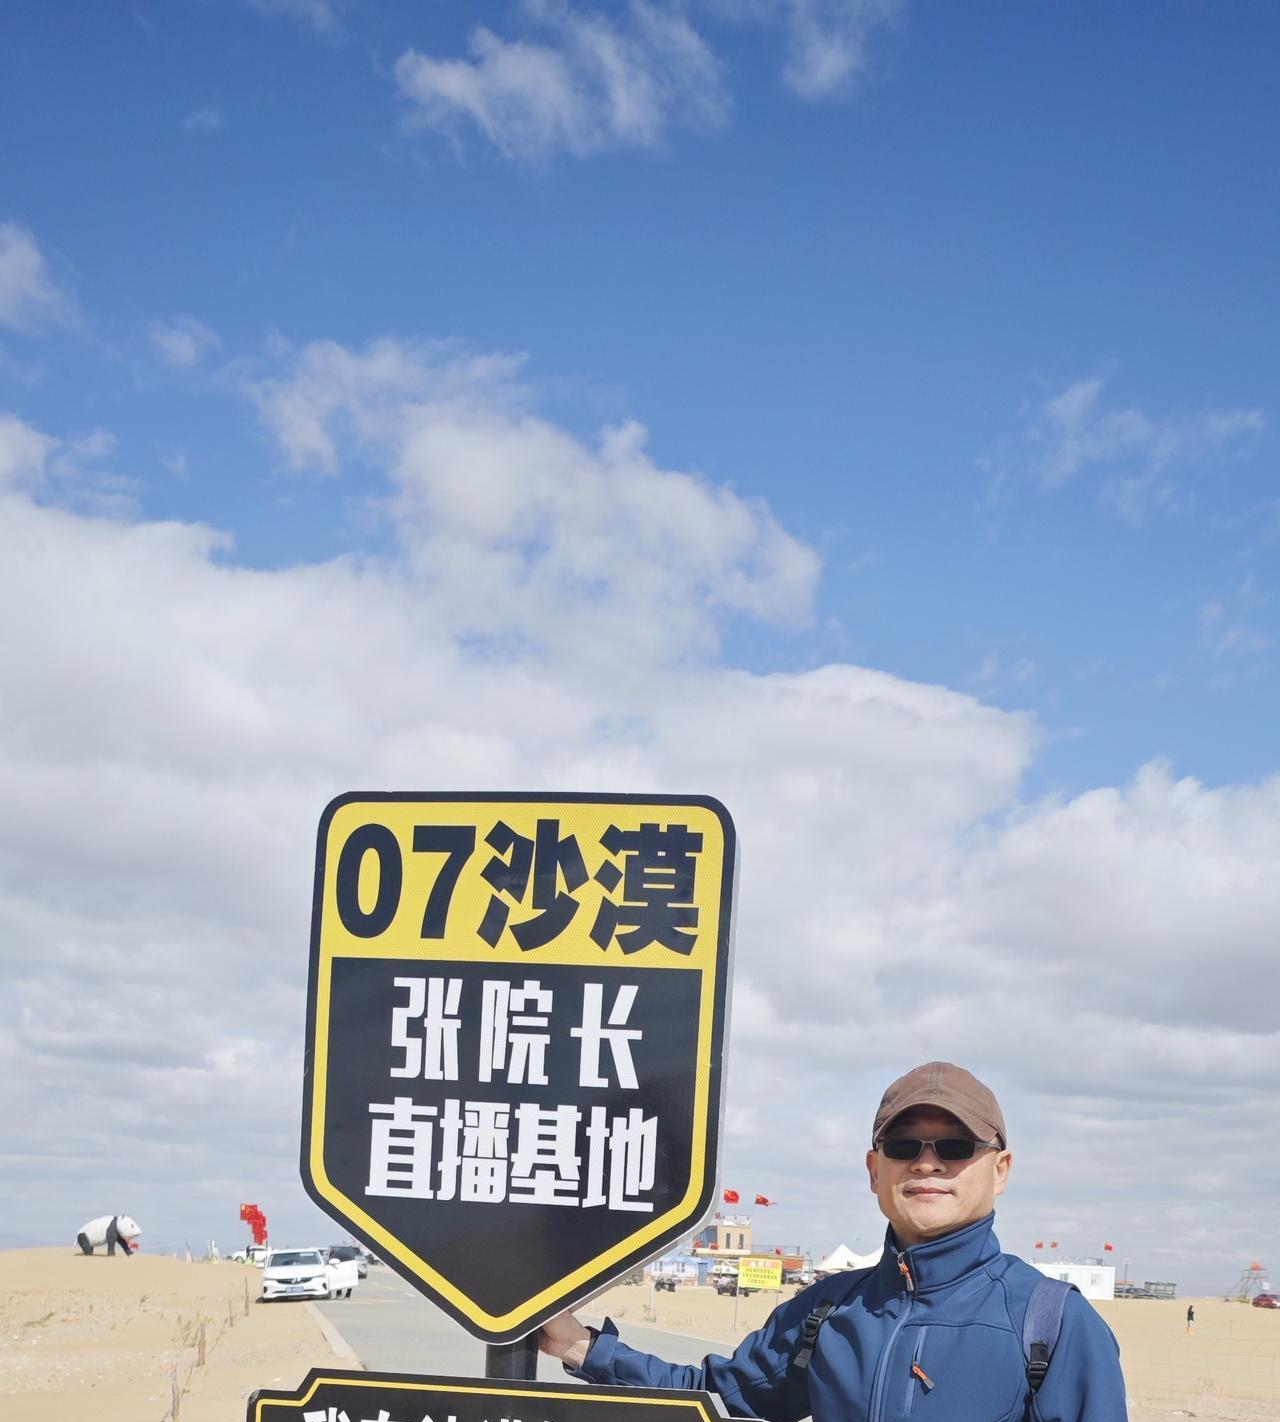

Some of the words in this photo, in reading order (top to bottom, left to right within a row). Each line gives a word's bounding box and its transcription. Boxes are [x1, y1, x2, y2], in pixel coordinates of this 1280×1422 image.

[336, 819, 703, 955] 07沙漠
[390, 977, 642, 1089] 张院长
[365, 1097, 658, 1212] 直播基地
